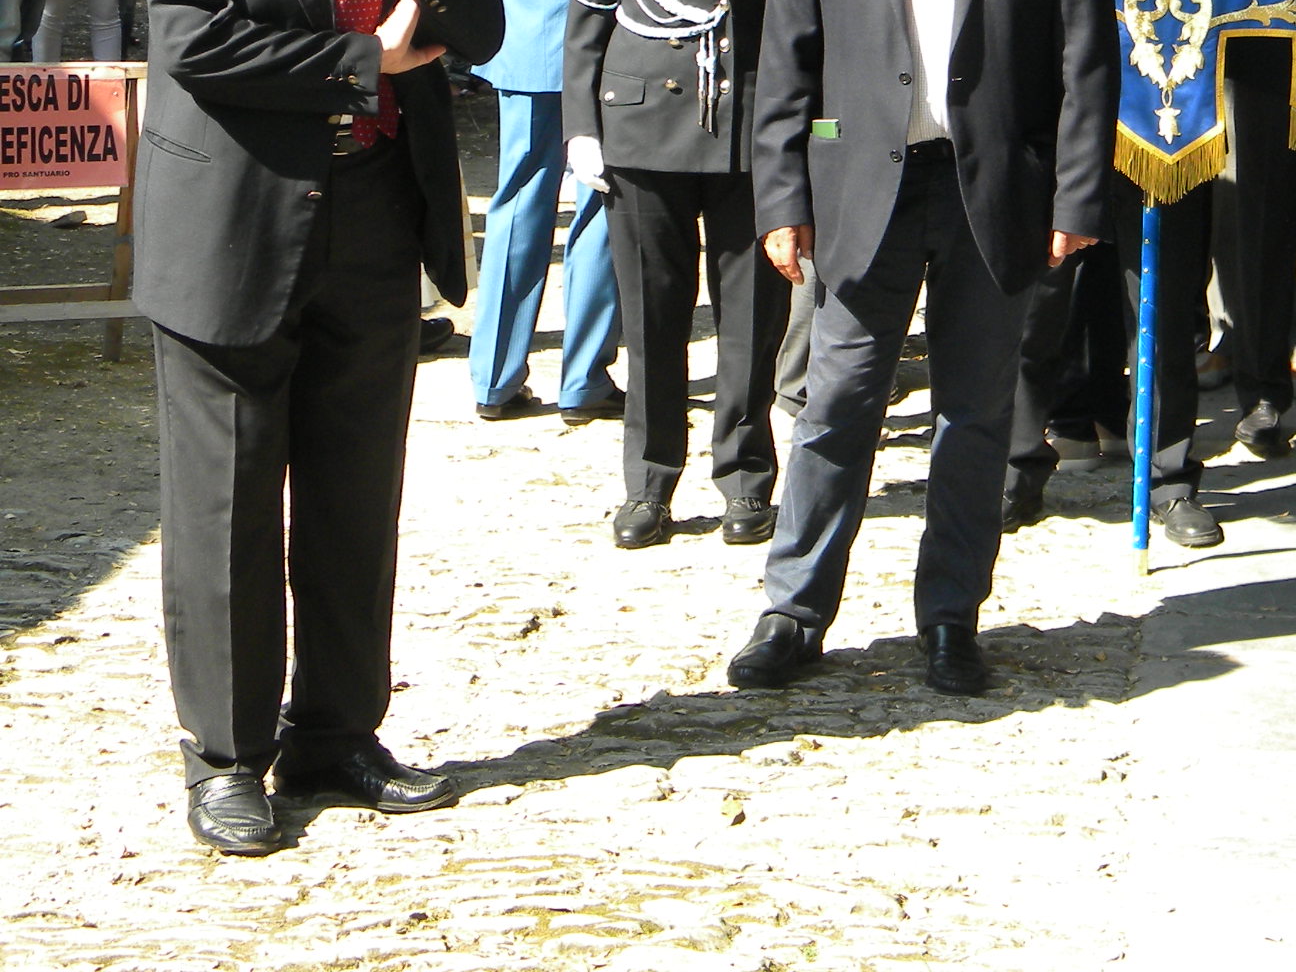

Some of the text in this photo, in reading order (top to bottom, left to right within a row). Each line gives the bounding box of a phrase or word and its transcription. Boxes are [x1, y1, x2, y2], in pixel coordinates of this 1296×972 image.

[0, 74, 90, 112] ESCA DI
[1, 124, 118, 165] EFICENZA
[22, 170, 70, 178] SANTUARIO
